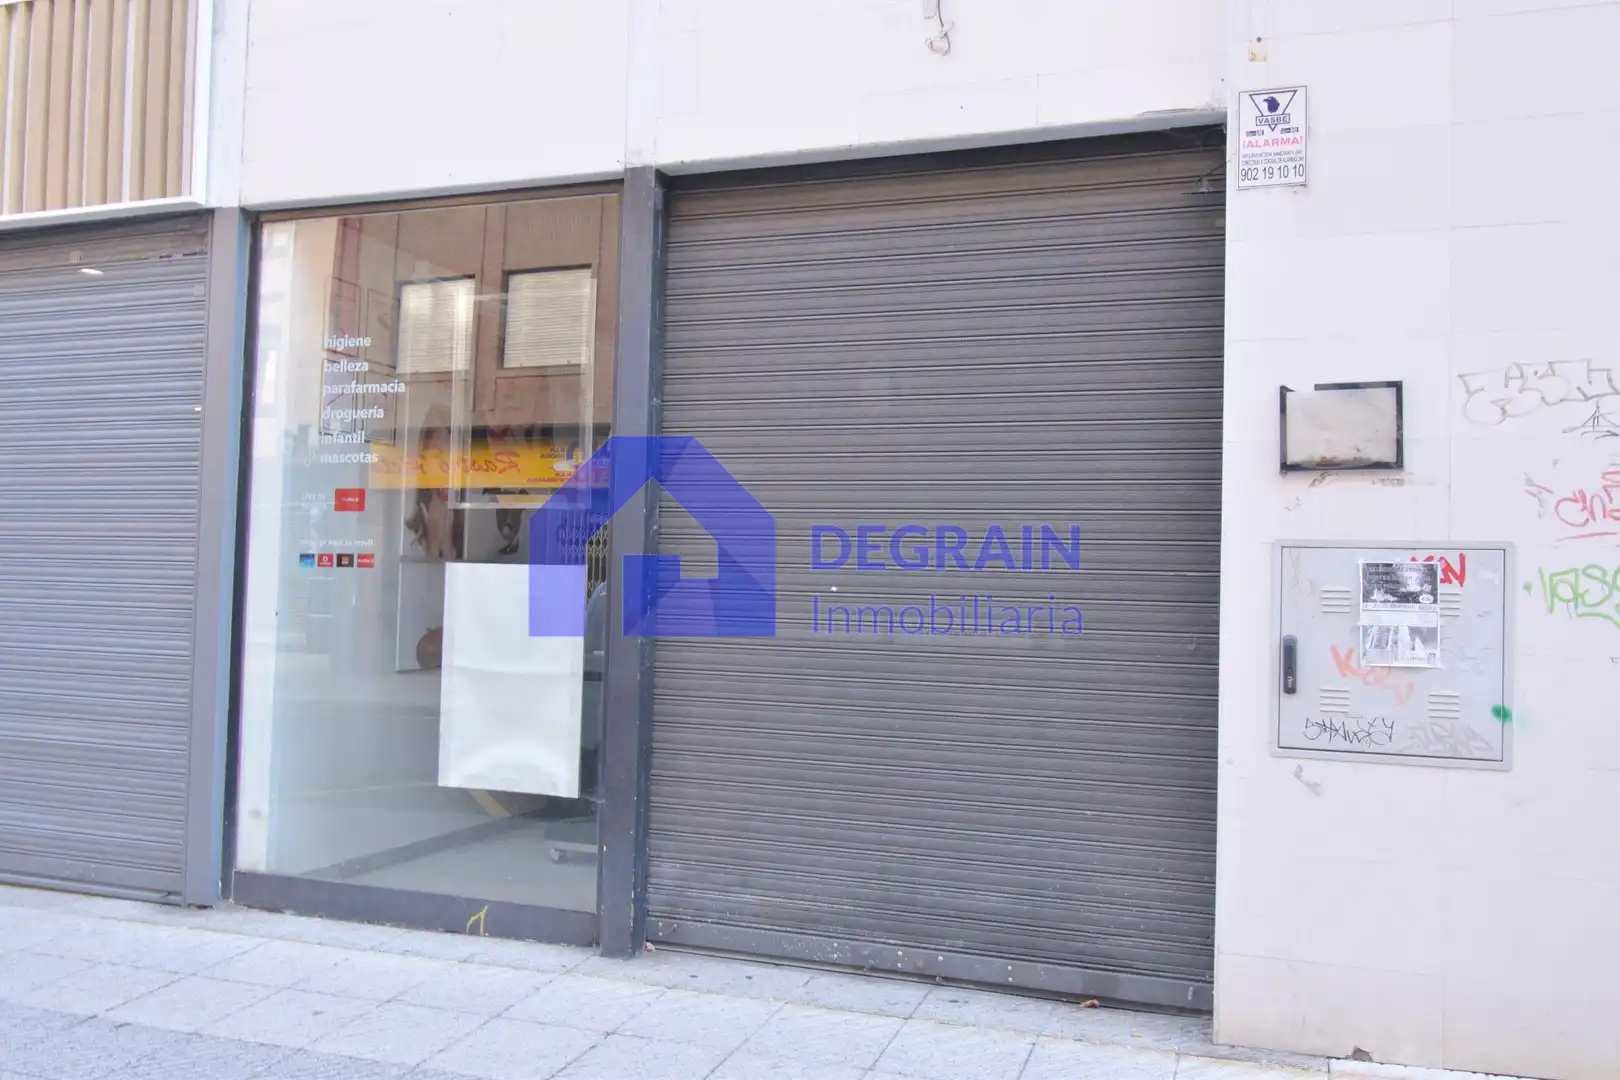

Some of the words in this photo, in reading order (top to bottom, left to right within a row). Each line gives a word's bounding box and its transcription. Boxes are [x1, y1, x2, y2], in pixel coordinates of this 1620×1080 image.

[1240, 168, 1259, 181] 902
[1262, 166, 1274, 180] 19
[1278, 165, 1289, 179] 10
[1293, 163, 1305, 177] 10
[324, 359, 369, 373] belleza
[322, 380, 406, 397] parafarmacia
[321, 405, 385, 422] droguería
[321, 430, 365, 445] infantil
[320, 450, 378, 464] mascotas
